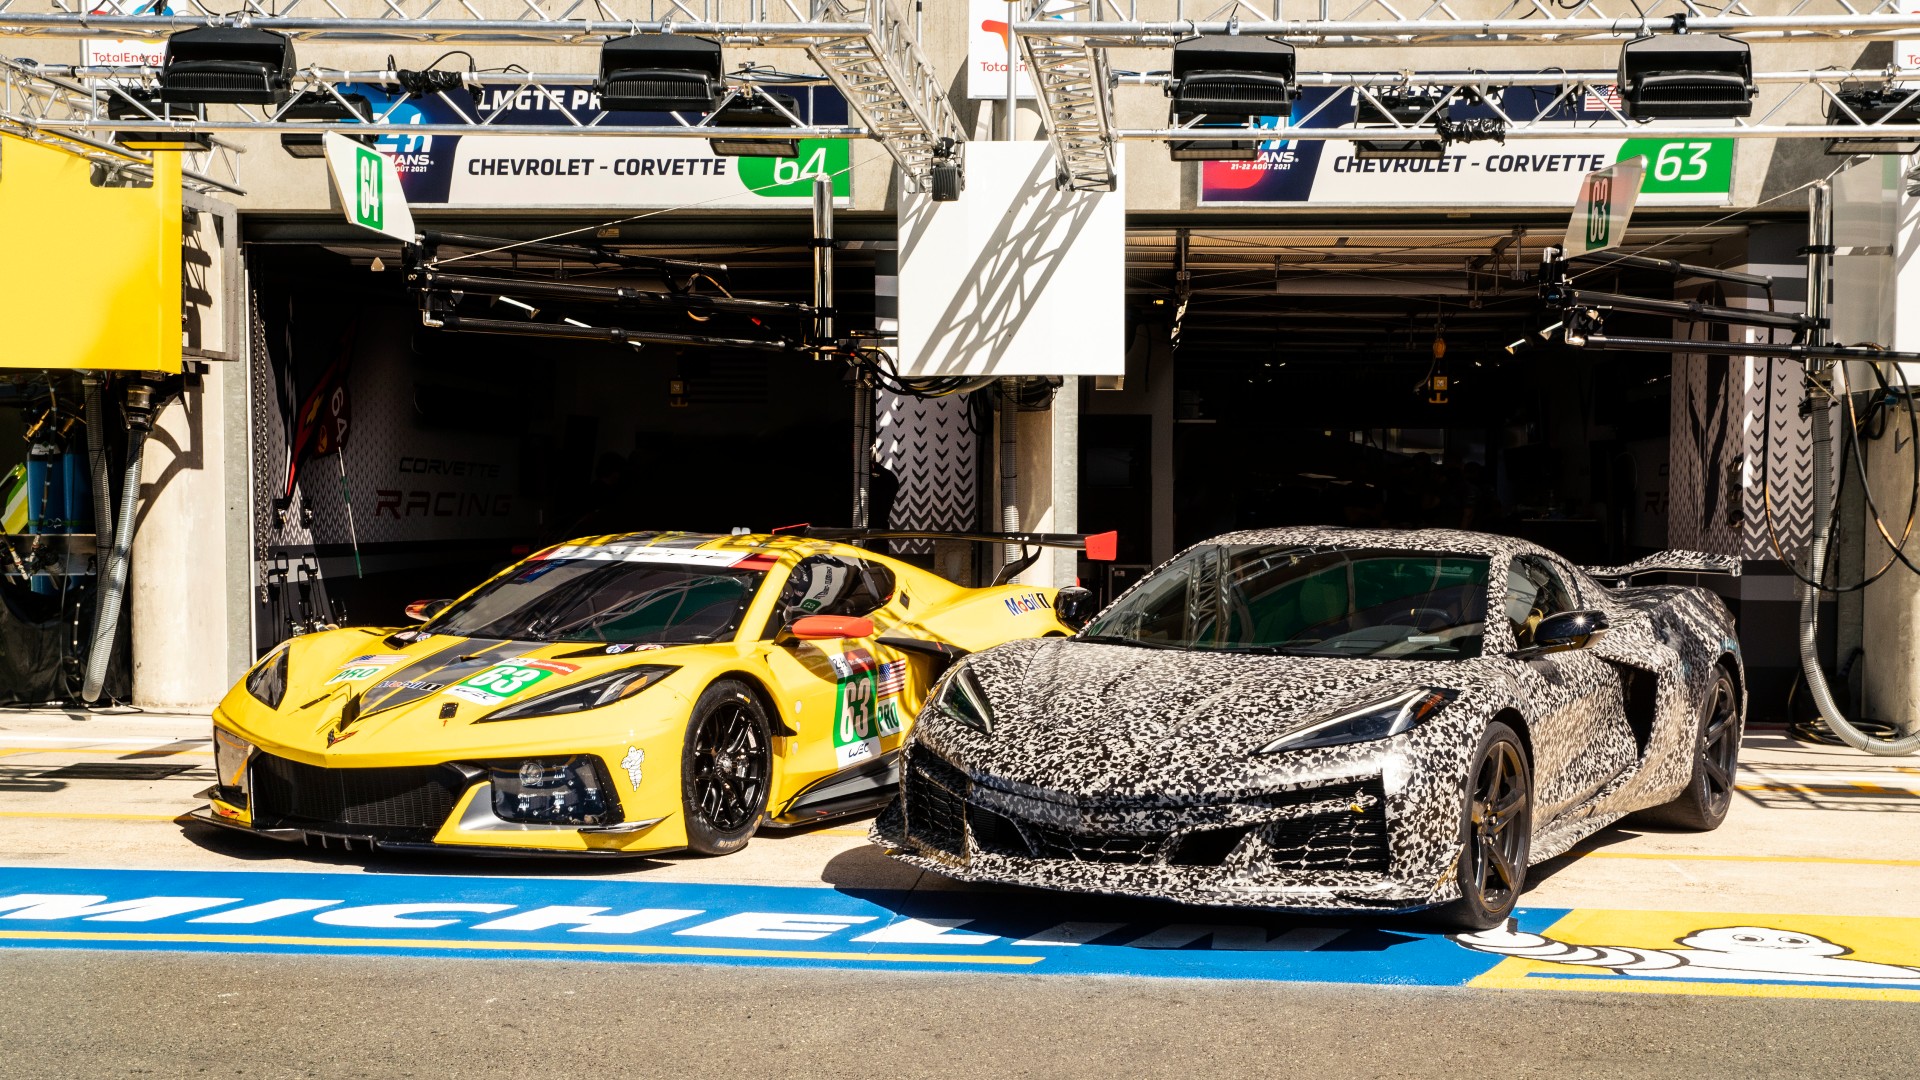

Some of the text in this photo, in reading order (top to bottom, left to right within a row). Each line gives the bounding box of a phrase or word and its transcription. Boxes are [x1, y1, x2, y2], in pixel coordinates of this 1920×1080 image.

[478, 90, 565, 110] LMGTE
[411, 165, 427, 173] 2021
[468, 158, 595, 176] CHEVROLET
[613, 158, 727, 176] CORVETTE
[774, 147, 828, 185] 64
[1333, 155, 1467, 174] CHEVROLET
[1485, 154, 1605, 172] CORVETTE
[1654, 142, 1712, 181] 63
[361, 156, 379, 223] 64
[1590, 177, 1608, 243] 63
[331, 386, 348, 444] 64
[399, 456, 501, 478] CORVETTE
[375, 489, 513, 519] RACING
[1004, 593, 1042, 616] Mobil
[329, 667, 379, 683] PRO
[467, 666, 541, 694] 63
[840, 677, 871, 743] 63
[877, 701, 900, 732] PRO
[848, 742, 870, 758] WEC
[0, 893, 1353, 951] MICHELIN
